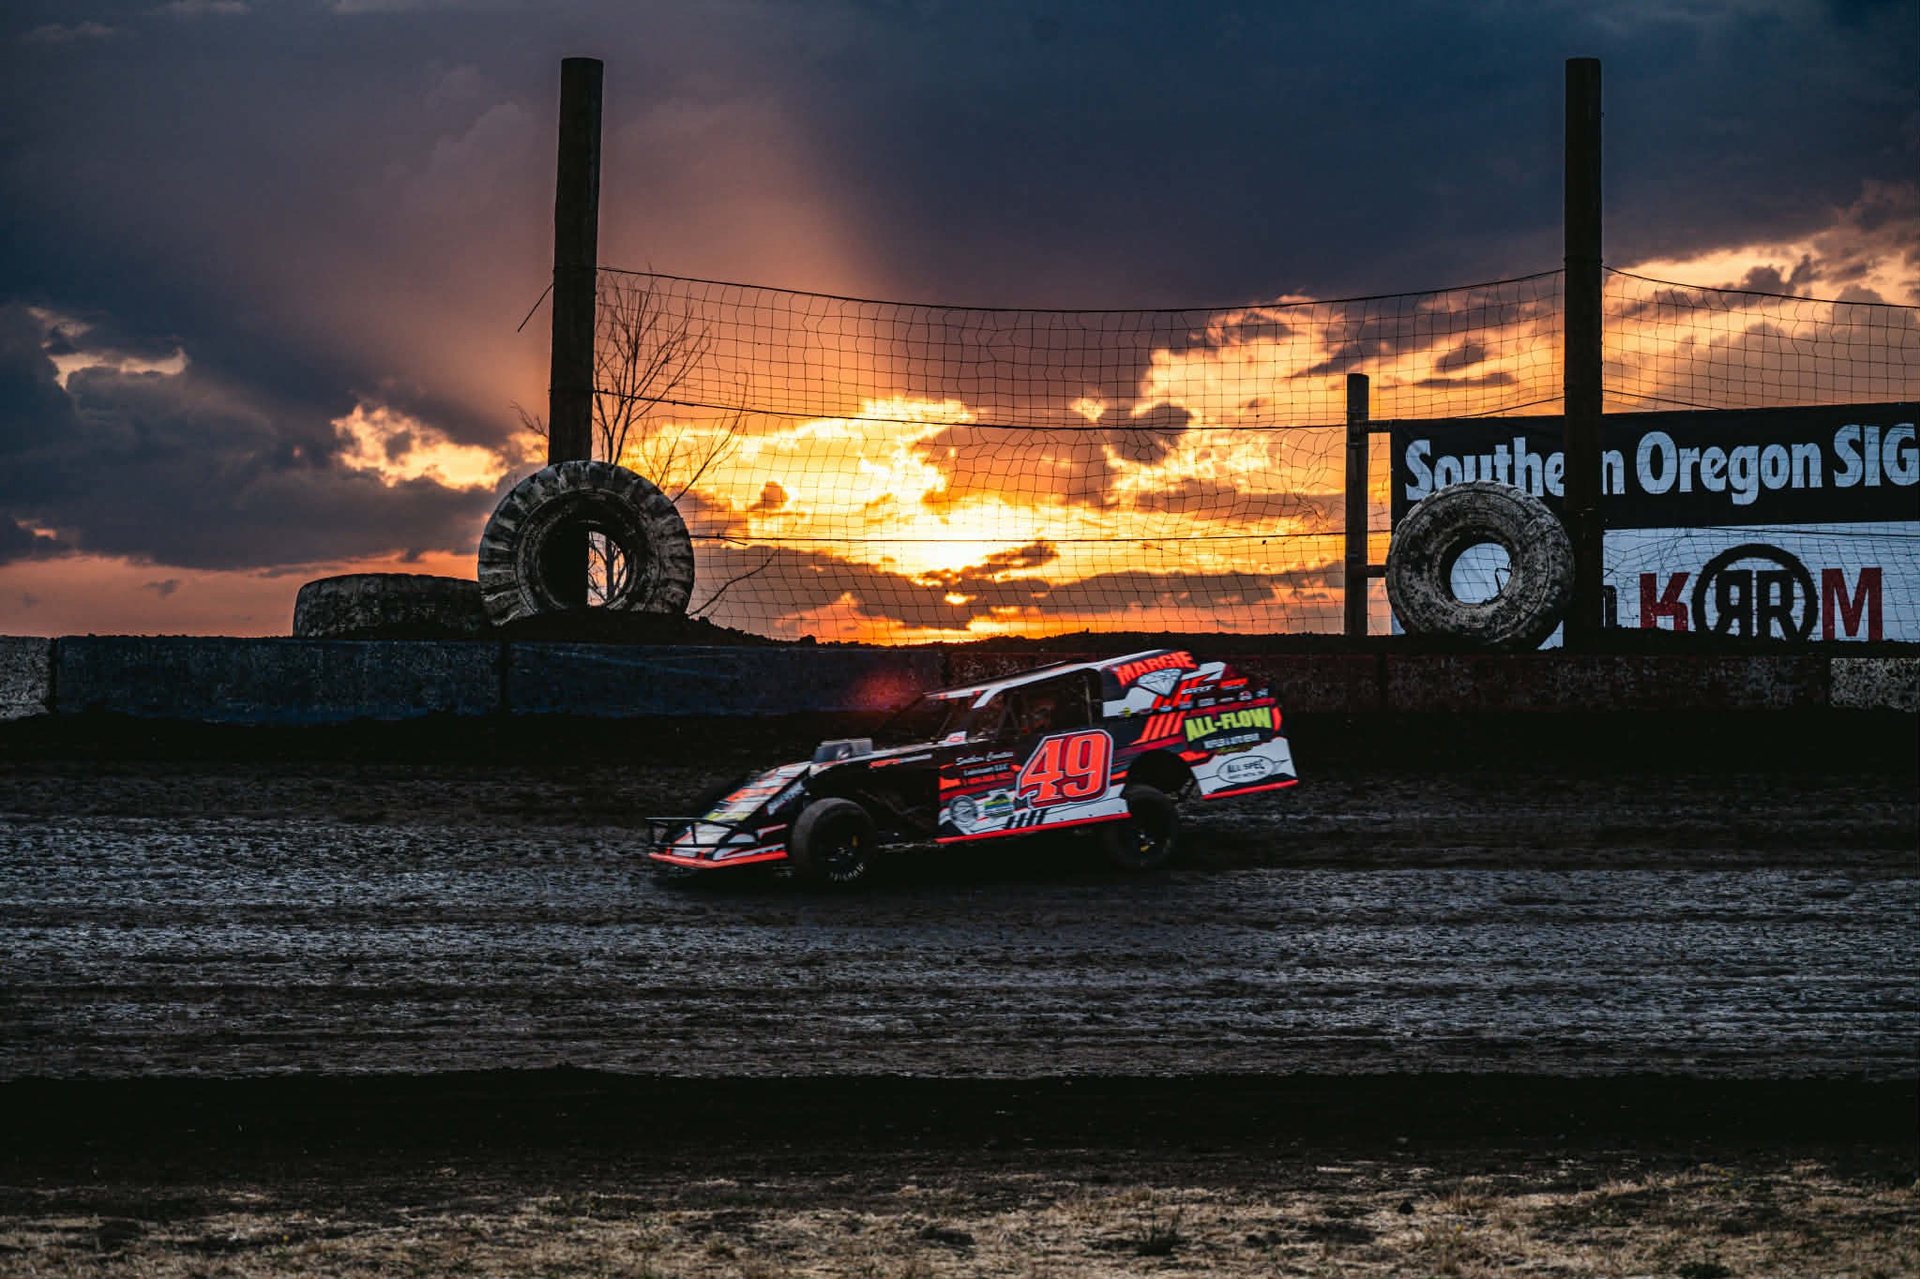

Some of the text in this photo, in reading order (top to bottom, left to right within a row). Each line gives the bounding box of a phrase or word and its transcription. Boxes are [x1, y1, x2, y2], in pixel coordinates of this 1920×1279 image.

[1405, 437, 1625, 500] Southen
[1637, 430, 1822, 504] Oregon
[1184, 707, 1272, 742] ALL-FLOW
[1018, 730, 1109, 806] 49
